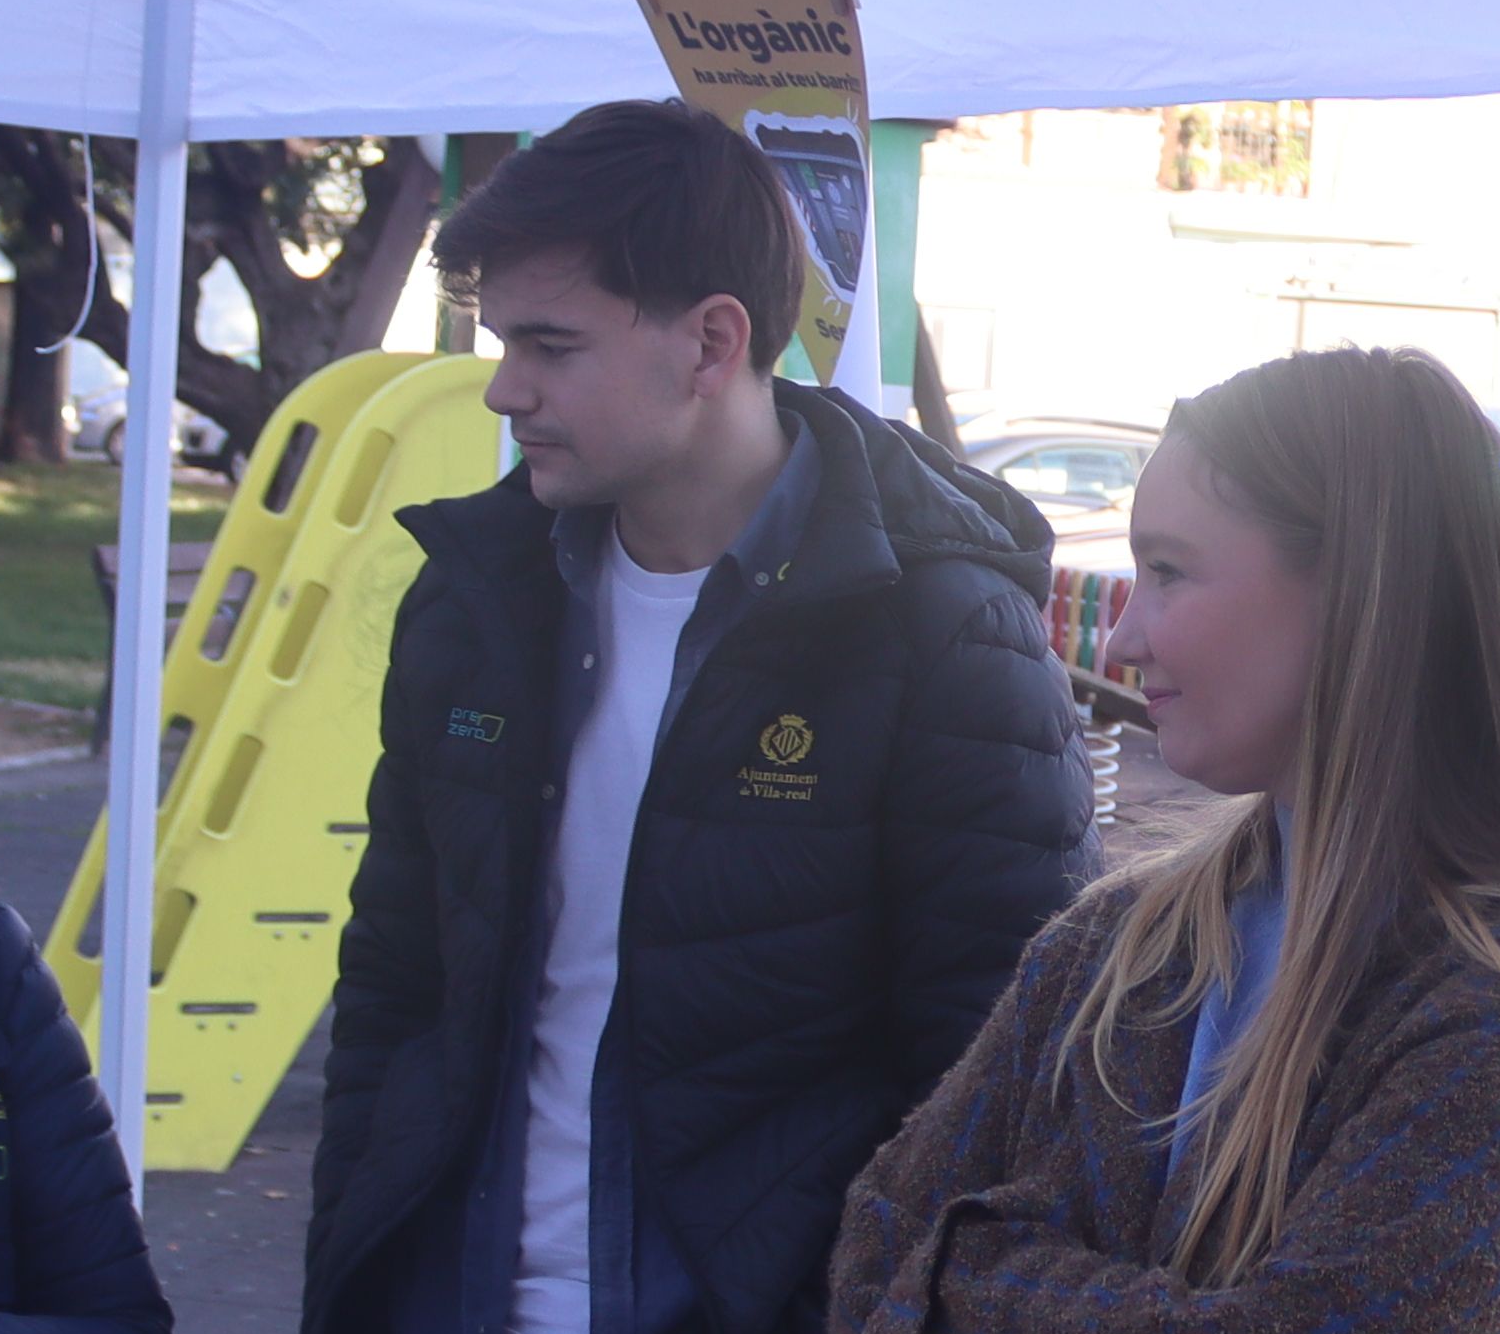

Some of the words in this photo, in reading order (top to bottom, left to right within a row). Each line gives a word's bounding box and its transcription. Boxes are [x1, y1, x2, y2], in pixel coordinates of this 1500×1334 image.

[667, 8, 852, 64] L'orgànic
[693, 68, 717, 84] ha
[717, 69, 770, 87] arribat
[770, 71, 788, 87] al
[787, 71, 818, 87] teu
[449, 707, 479, 722] pre
[447, 723, 485, 740] zero
[737, 766, 818, 785] Ajuntament
[751, 784, 812, 801] Vila-real
